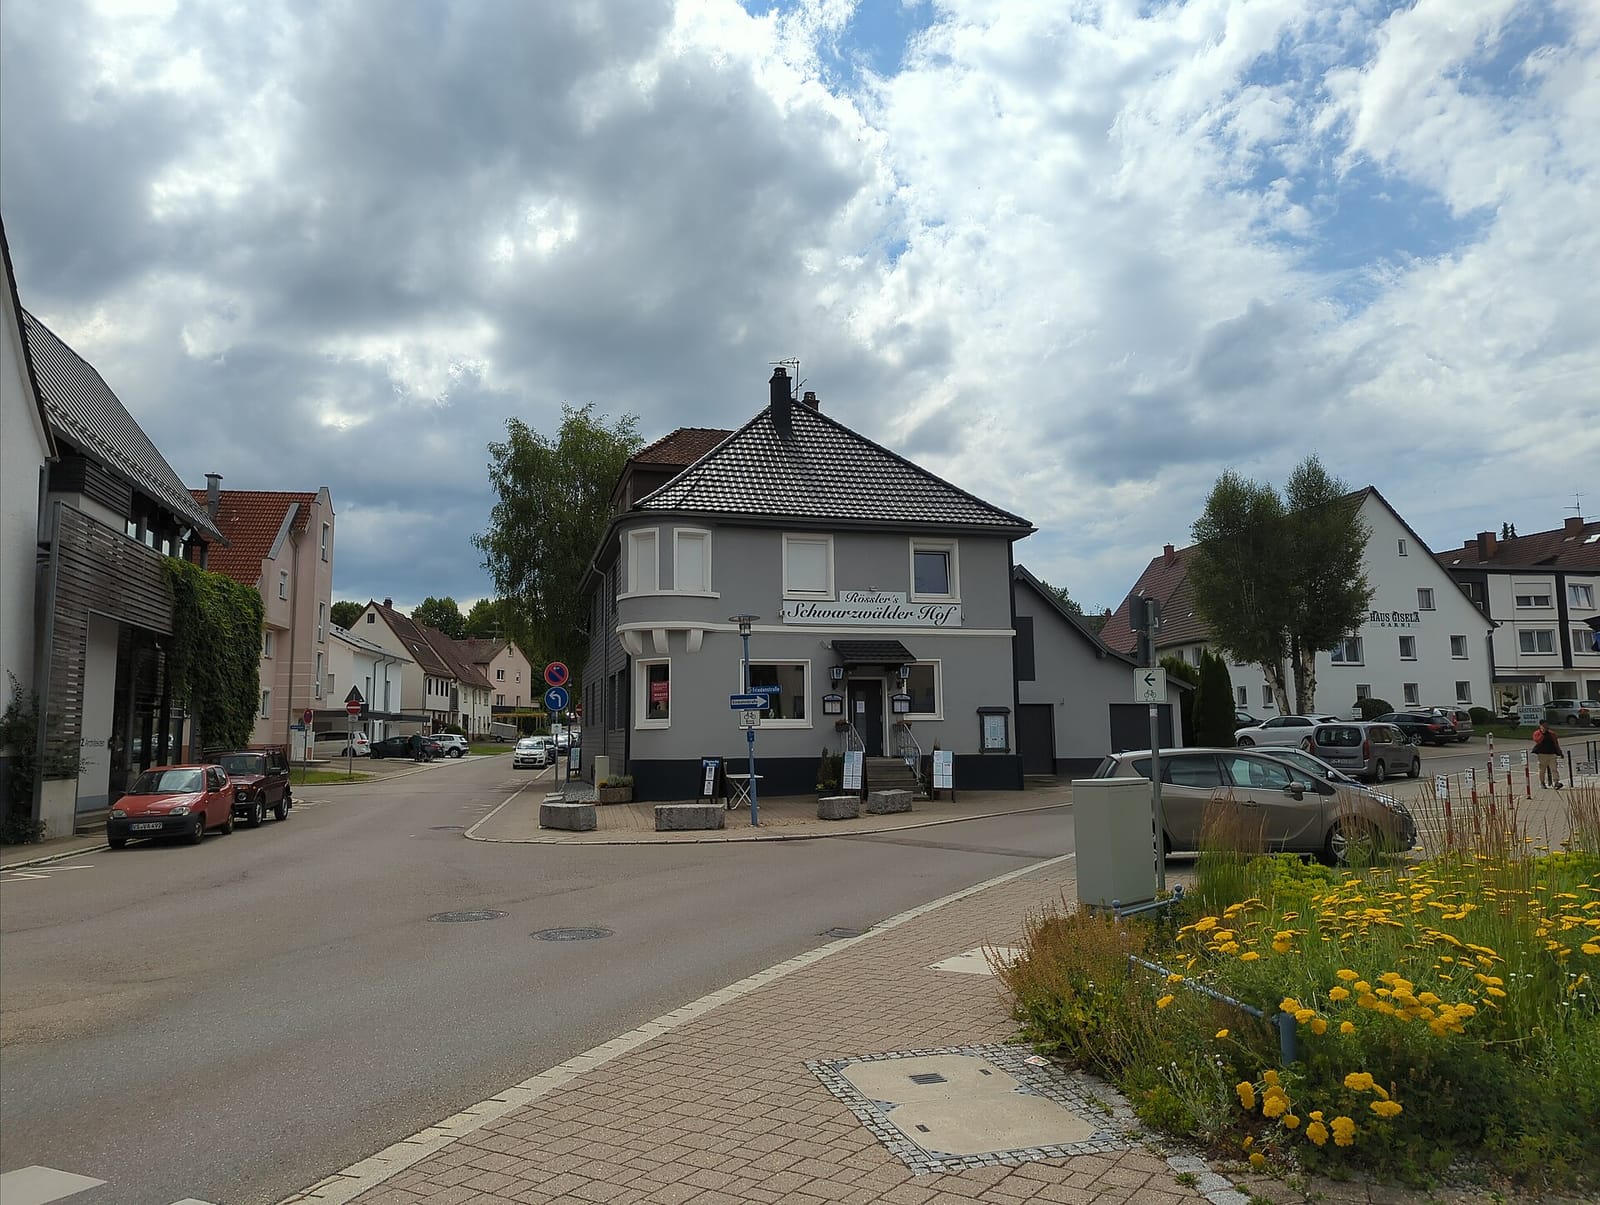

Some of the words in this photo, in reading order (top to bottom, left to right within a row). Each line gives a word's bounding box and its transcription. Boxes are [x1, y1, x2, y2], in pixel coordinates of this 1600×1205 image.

[844, 591, 899, 604] Rössler's
[787, 602, 914, 620] Schwarzwälder
[917, 605, 957, 626] Hof
[1370, 610, 1390, 622] HAUS
[1391, 610, 1420, 622] GISELA
